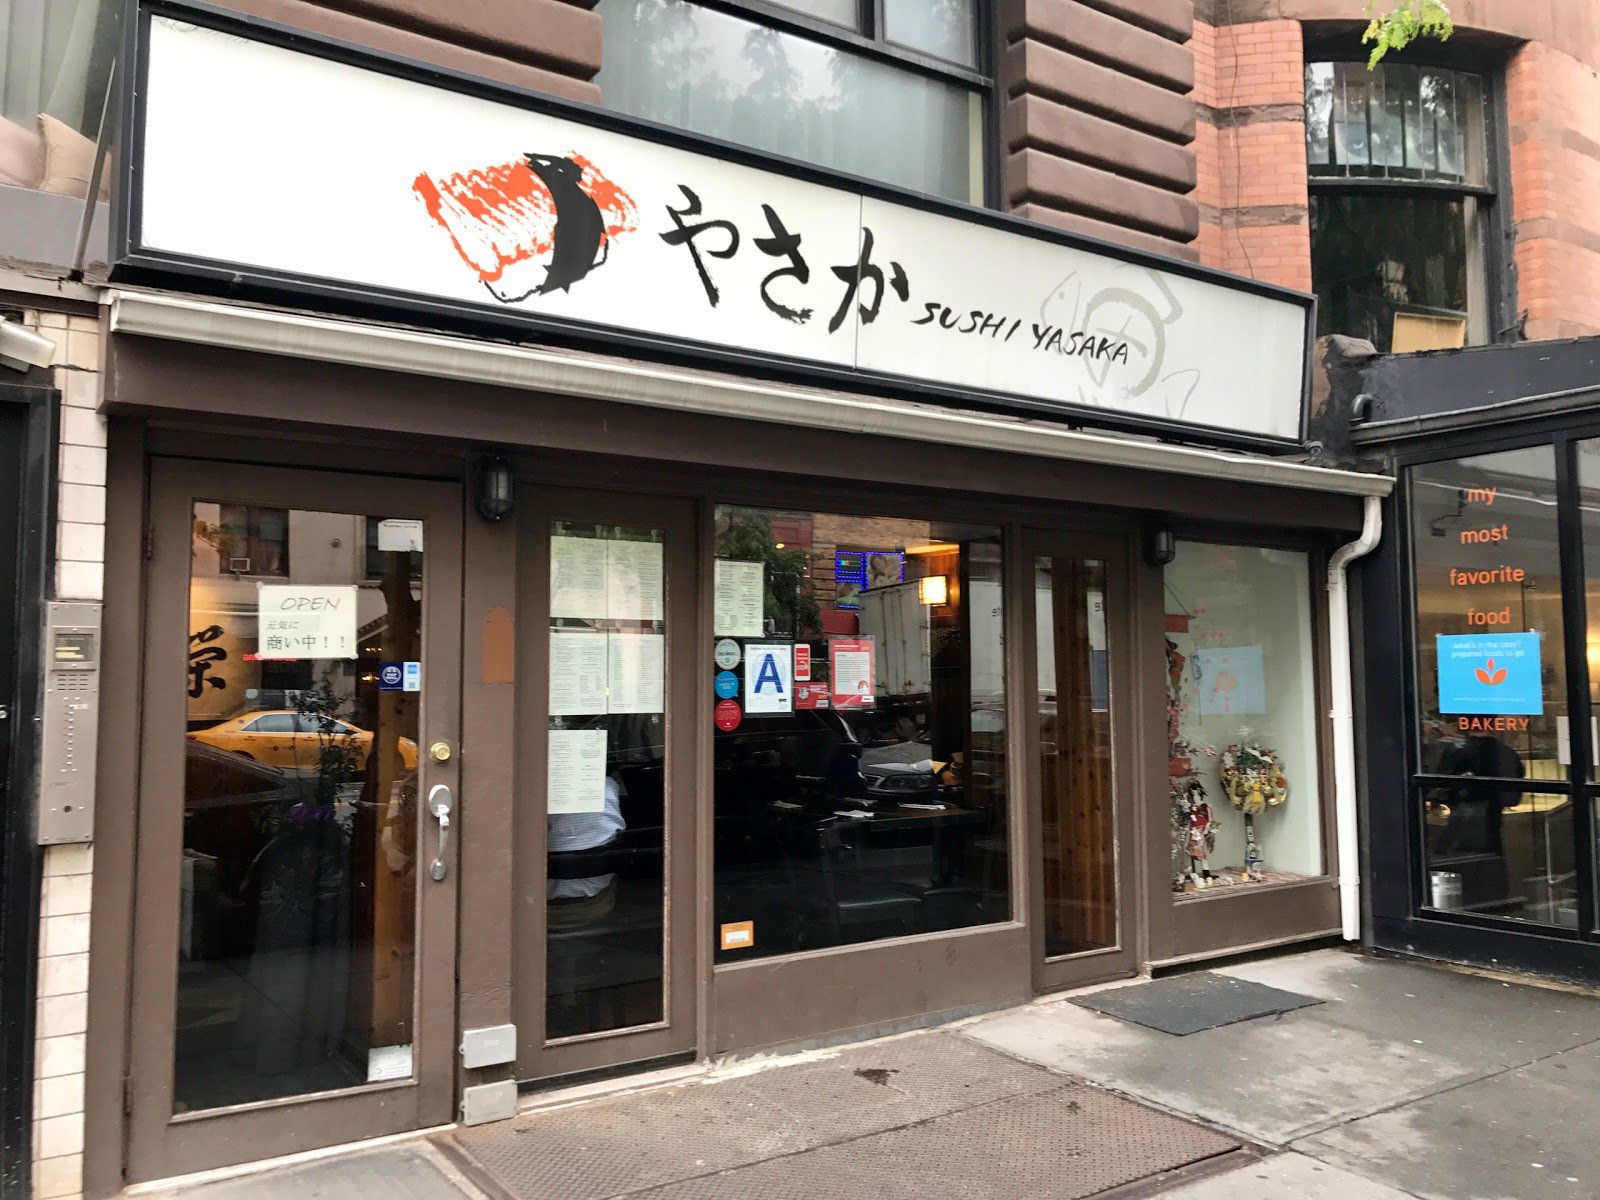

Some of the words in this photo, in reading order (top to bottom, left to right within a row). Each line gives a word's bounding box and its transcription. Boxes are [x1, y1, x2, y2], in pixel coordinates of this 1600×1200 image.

[659, 184, 910, 334] やさか
[913, 302, 1022, 341] SUSHI
[1032, 323, 1128, 365] YASAKA
[1467, 485, 1497, 505] my
[1460, 524, 1509, 544] most
[1449, 565, 1525, 586] favorite
[280, 597, 342, 611] OPEN
[1467, 607, 1511, 626] food
[753, 653, 784, 694] A
[1458, 717, 1529, 731] BAKERY
